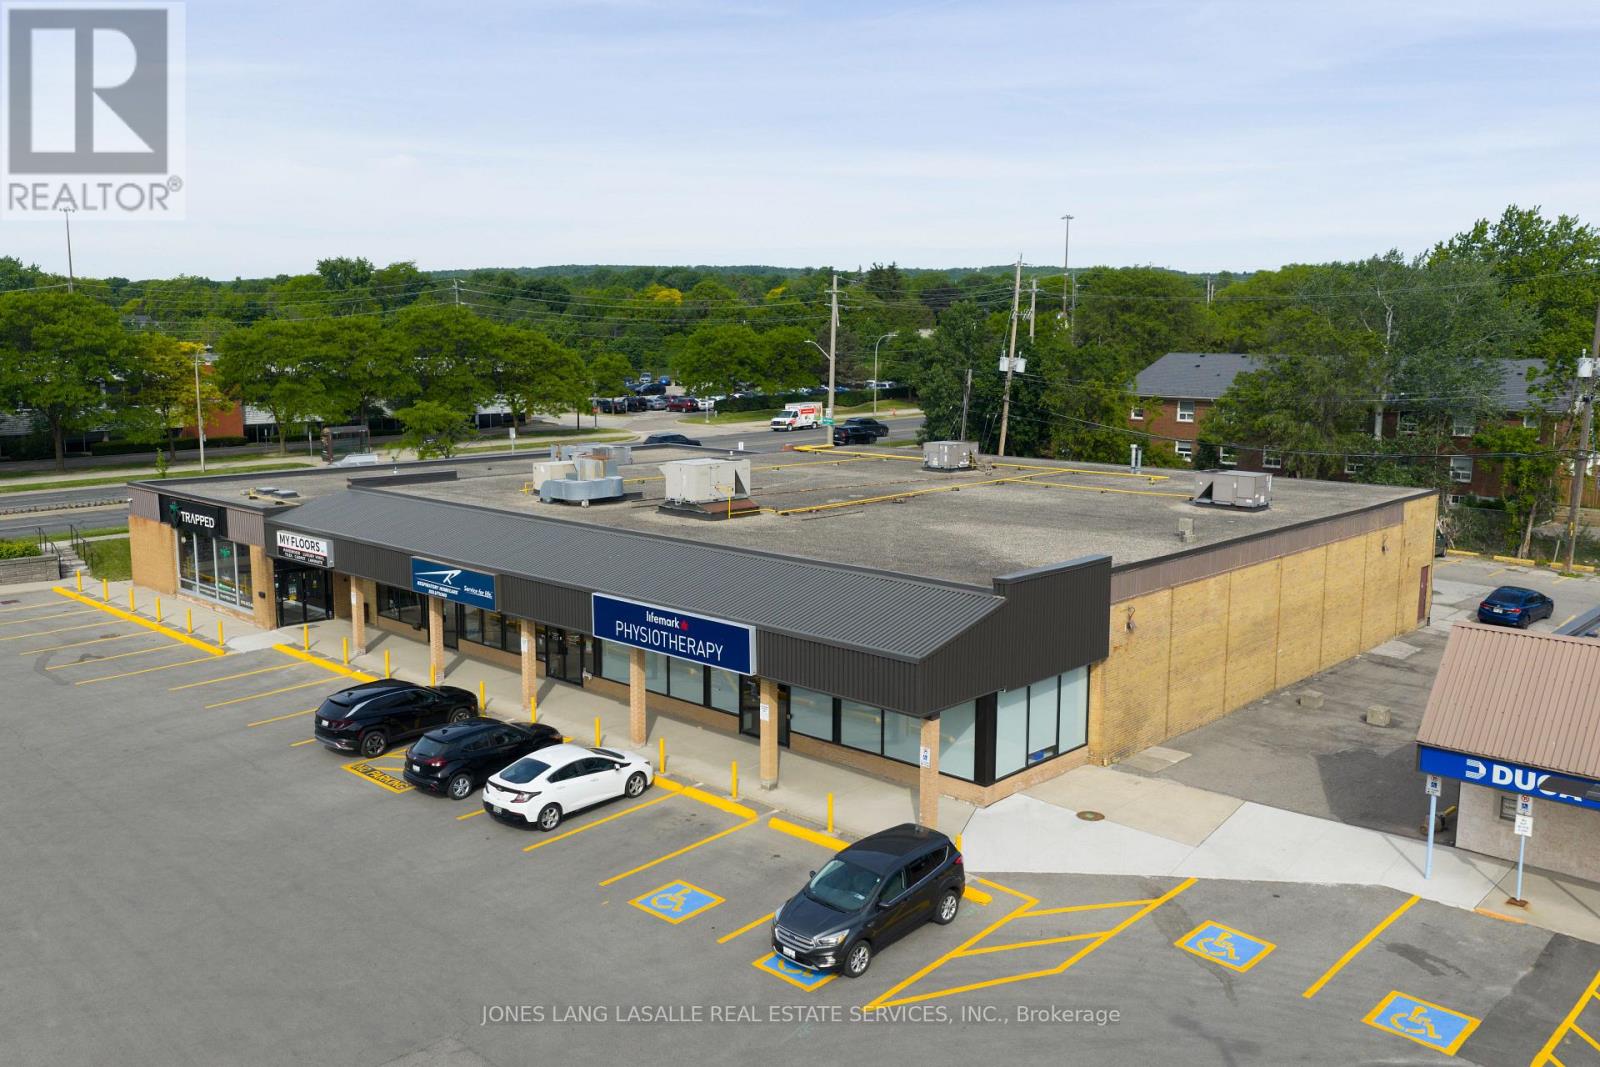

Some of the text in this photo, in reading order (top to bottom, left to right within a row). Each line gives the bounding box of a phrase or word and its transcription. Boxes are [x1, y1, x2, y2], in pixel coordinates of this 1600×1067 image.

[180, 511, 215, 529] TRAPPED
[279, 533, 321, 553] MY FLOORS
[646, 610, 680, 629] lifemark
[615, 620, 724, 661] PHYSIOTHERAPY
[1492, 764, 1582, 802] DU
